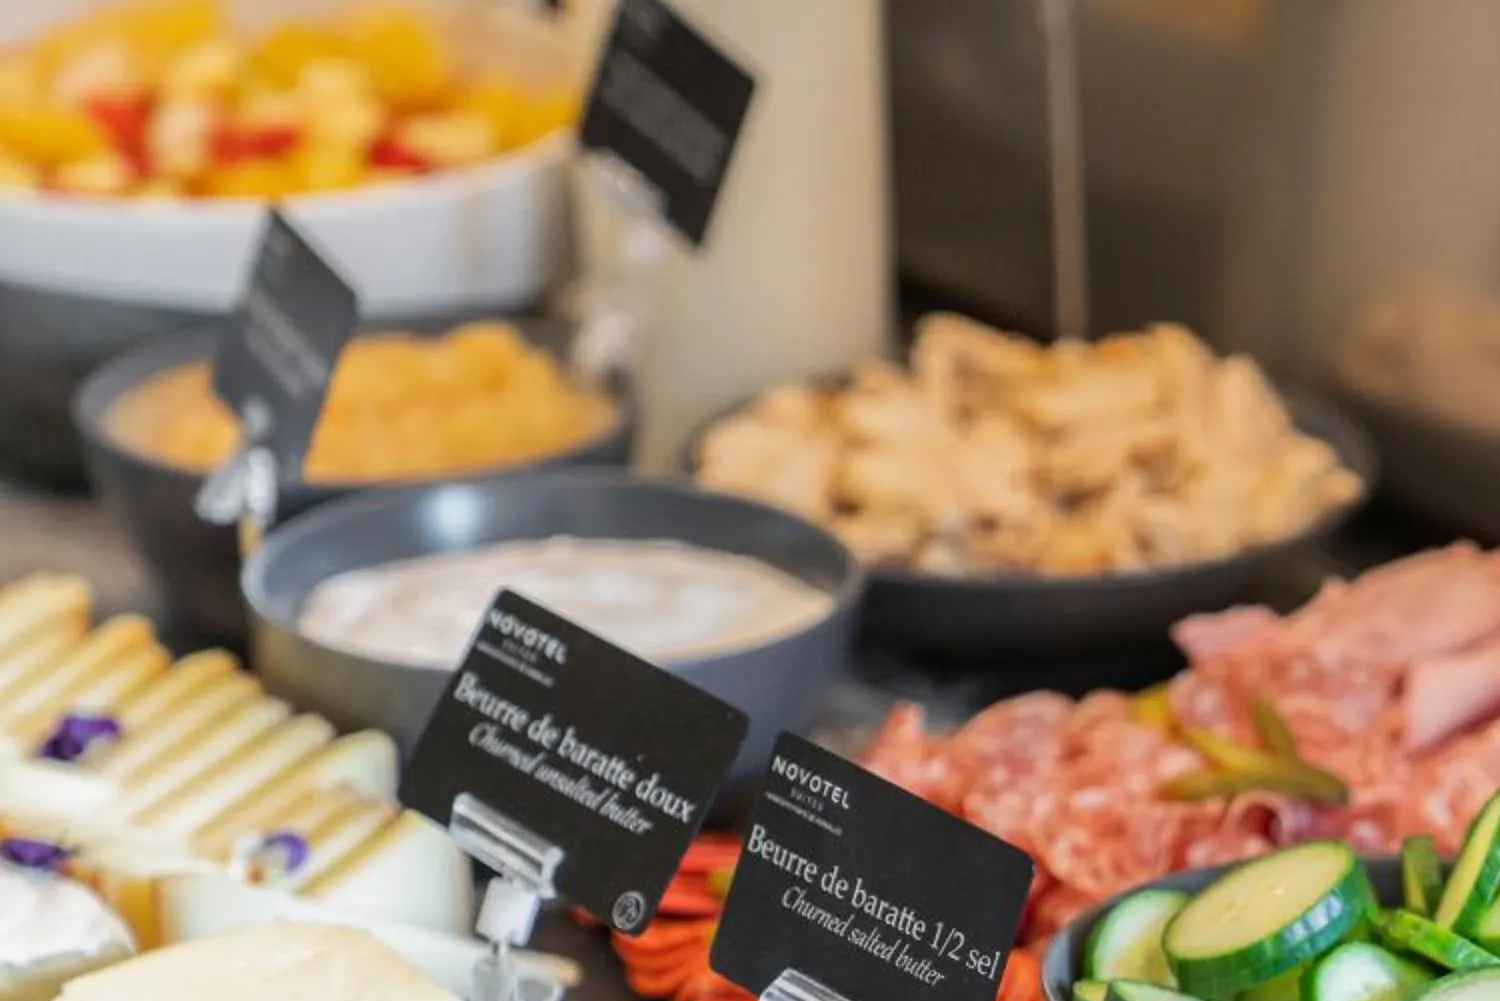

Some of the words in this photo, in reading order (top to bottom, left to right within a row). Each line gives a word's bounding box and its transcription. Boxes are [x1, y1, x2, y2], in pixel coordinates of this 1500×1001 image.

[488, 608, 567, 665] NOVOTEL
[453, 671, 530, 732] Beurre
[527, 713, 560, 749] de
[557, 726, 636, 791] baratte
[635, 772, 697, 824] doux
[468, 721, 547, 774] Churned
[533, 763, 614, 811] unsalted
[600, 791, 655, 834] butter
[771, 755, 850, 810] NOVOTEL
[747, 823, 818, 883] Beurre
[820, 864, 849, 899] de
[850, 877, 927, 941] baratte
[930, 921, 966, 962] 1/2
[965, 949, 1001, 980] sel
[781, 885, 856, 937] Churned
[847, 926, 902, 963] salted
[894, 943, 946, 987] butter
